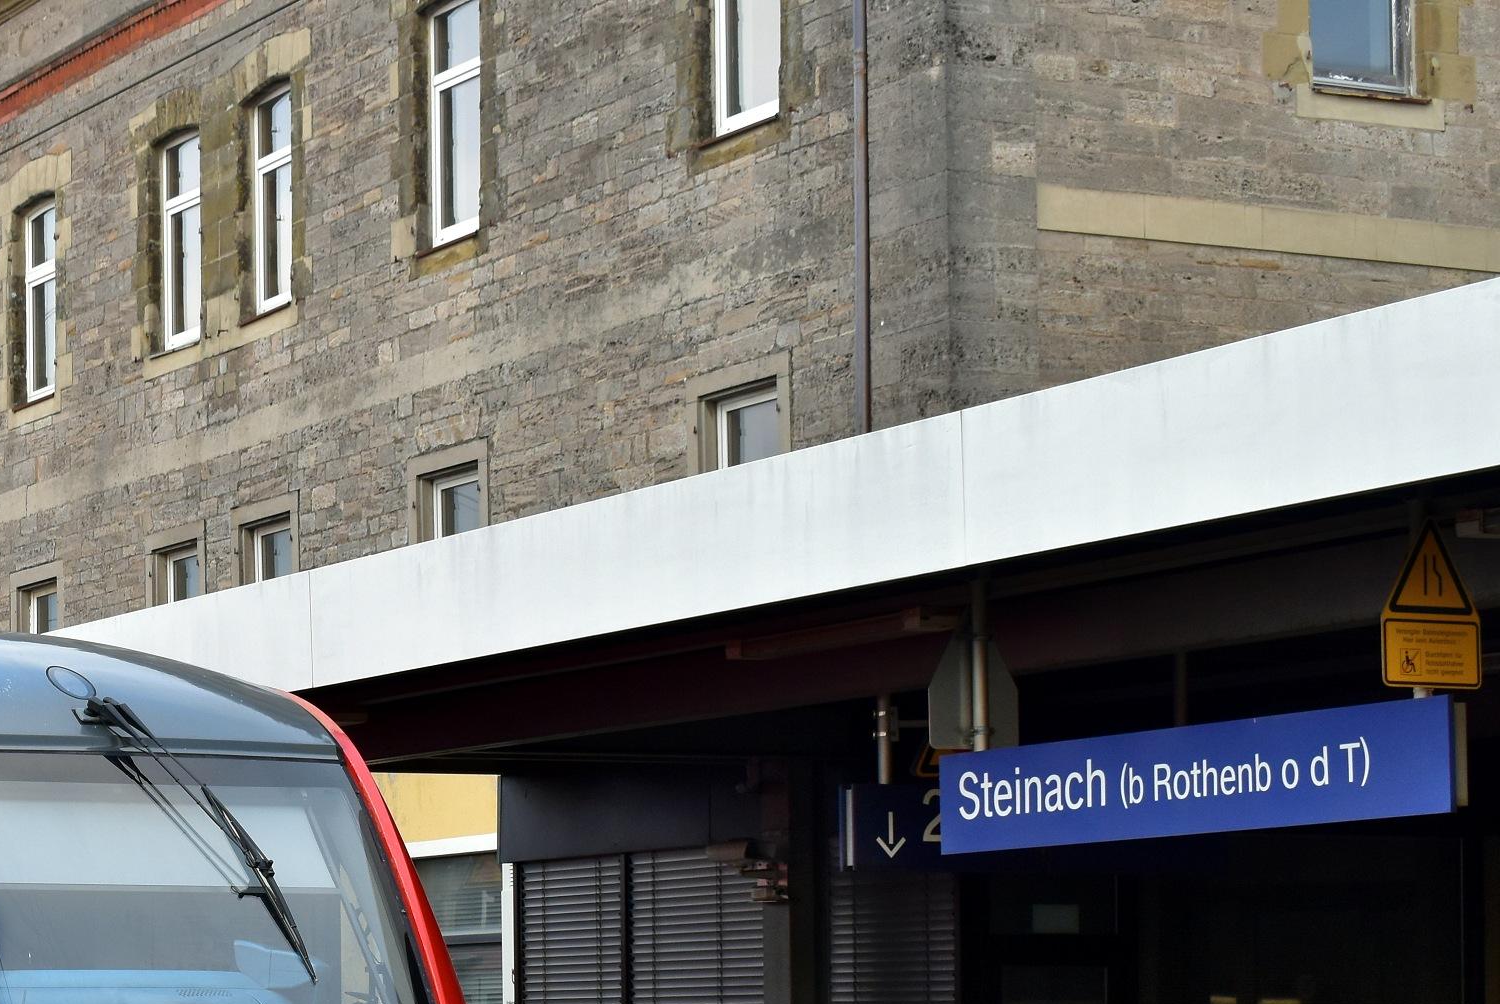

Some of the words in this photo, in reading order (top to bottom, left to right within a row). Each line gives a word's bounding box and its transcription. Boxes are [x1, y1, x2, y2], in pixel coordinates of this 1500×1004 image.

[959, 758, 1106, 820] Steinach
[1120, 762, 1144, 809] (b
[1153, 753, 1272, 801] Rothenb
[1281, 758, 1299, 789] o
[1310, 745, 1329, 786] d
[1340, 736, 1370, 787] T)
[922, 788, 941, 843] 2
